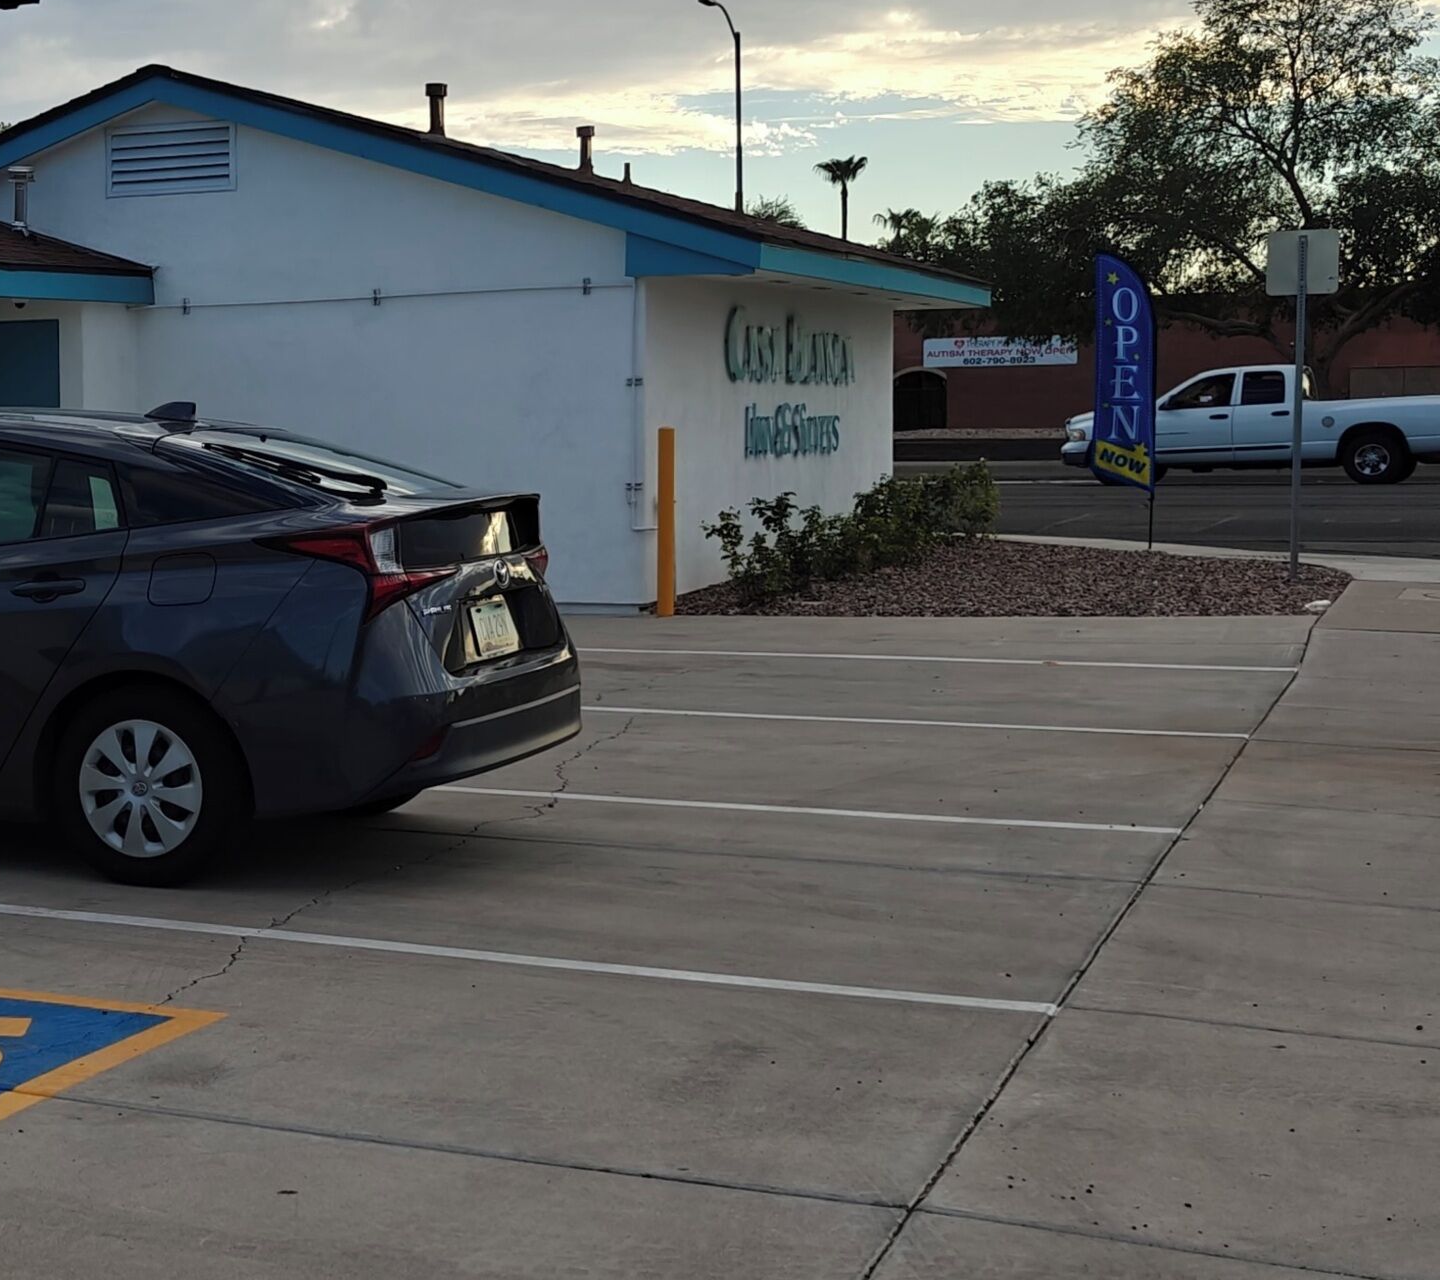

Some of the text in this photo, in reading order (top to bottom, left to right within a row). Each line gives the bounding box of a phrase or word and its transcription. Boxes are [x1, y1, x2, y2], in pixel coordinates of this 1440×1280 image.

[926, 350, 965, 358] AUTISM
[968, 348, 1013, 357] THERAPY
[1016, 348, 1041, 357] NOW
[1109, 287, 1142, 440] OPEN
[1099, 448, 1146, 474] NOW
